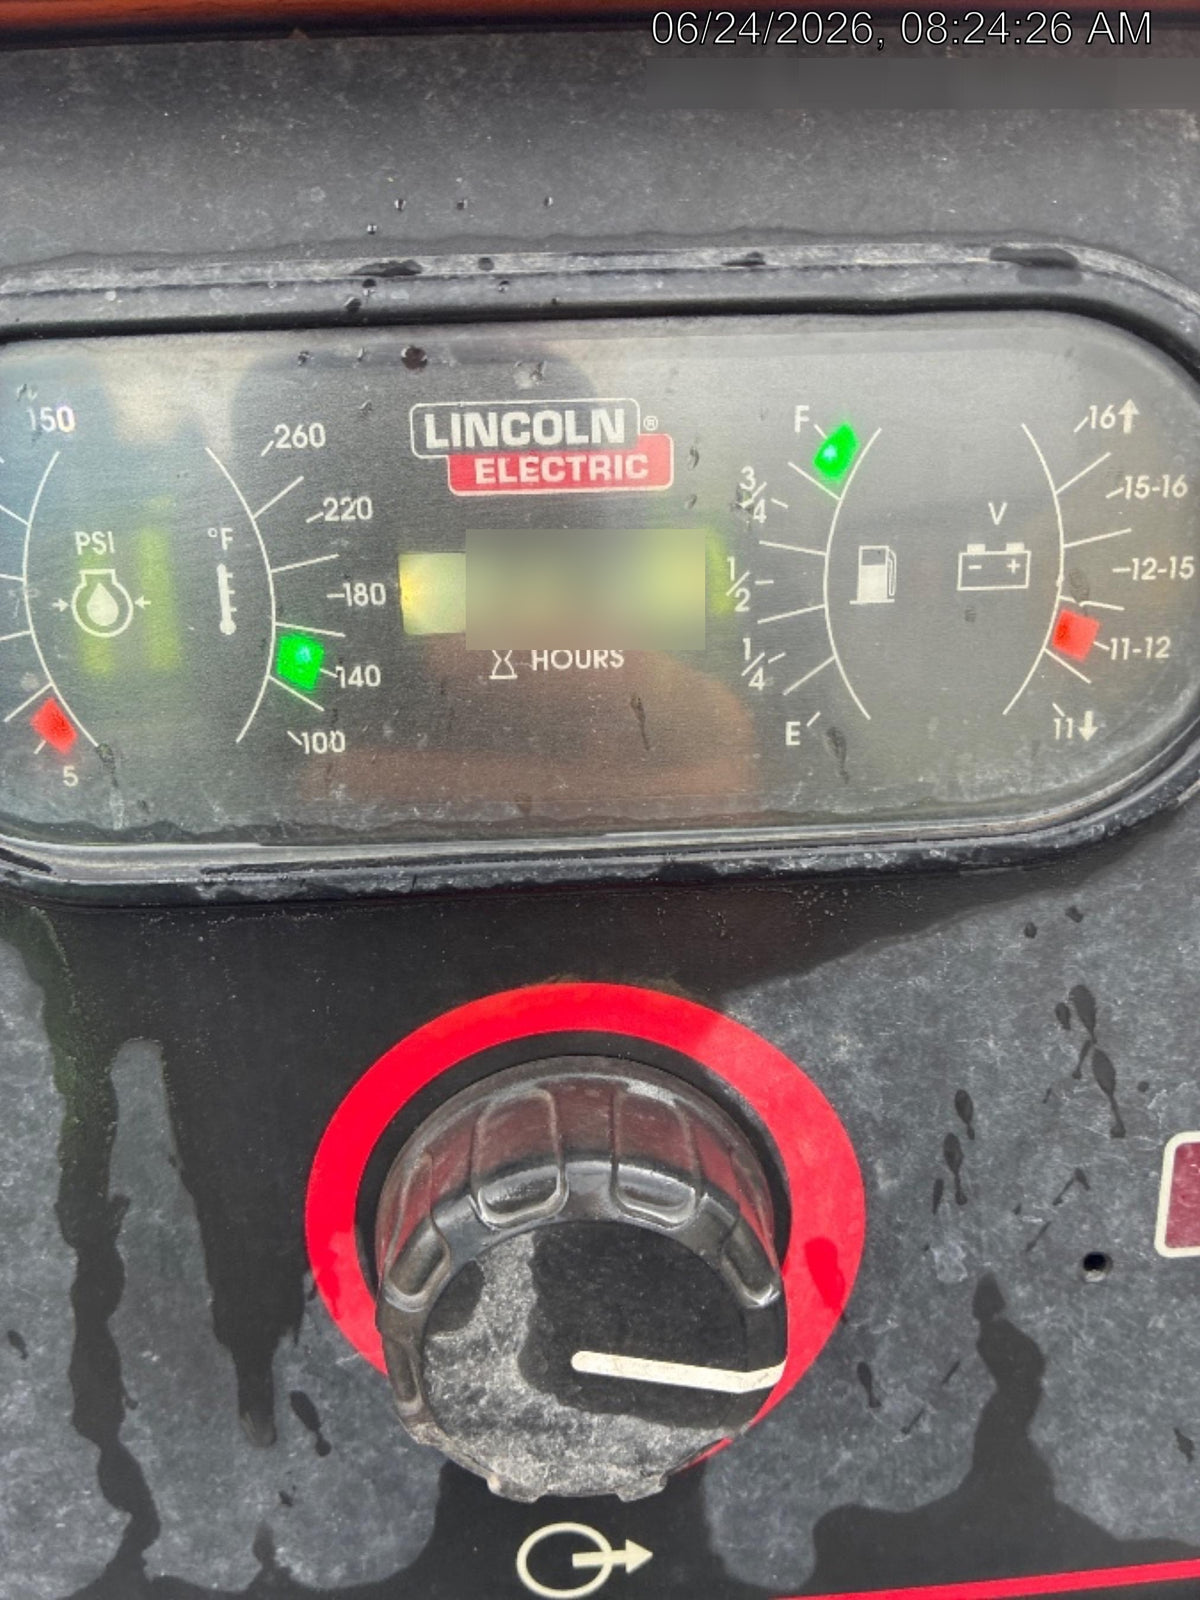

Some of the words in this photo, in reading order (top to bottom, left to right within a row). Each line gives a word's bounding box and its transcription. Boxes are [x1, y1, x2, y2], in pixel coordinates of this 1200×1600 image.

[27, 406, 76, 433] 150
[423, 408, 626, 449] LINCOLN
[794, 405, 810, 433] F
[273, 422, 327, 450] 260
[473, 453, 650, 485] ELECTRIC
[1124, 474, 1188, 500] 15-16
[322, 496, 374, 523] 220
[988, 502, 1008, 526] V
[74, 531, 116, 555] PSI
[207, 527, 234, 551] °F
[1131, 556, 1196, 581] 12-15
[342, 582, 387, 608] 180
[726, 556, 751, 612] 1/2
[531, 650, 625, 671] HOURS
[1108, 636, 1171, 661] 11-12
[336, 665, 382, 689] 140
[741, 637, 766, 691] 1/4
[300, 729, 346, 755] 100
[785, 721, 801, 746] E
[62, 764, 79, 786] 5
